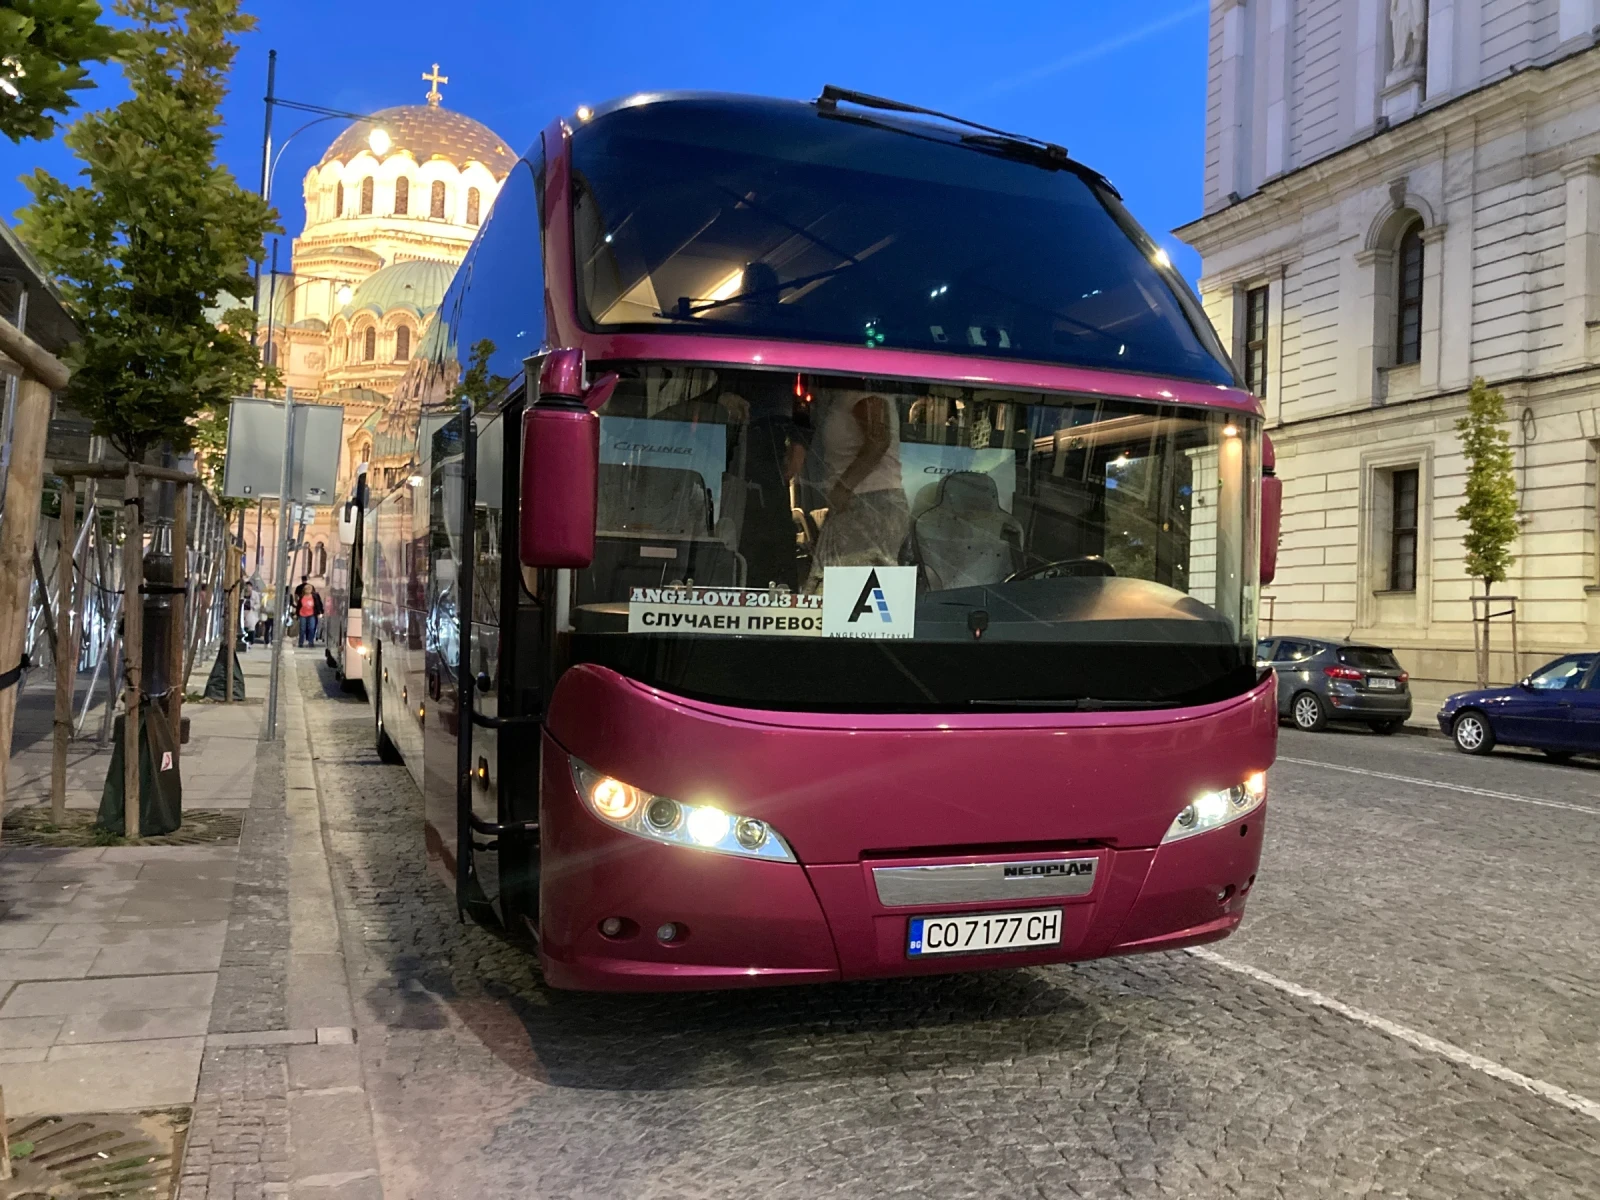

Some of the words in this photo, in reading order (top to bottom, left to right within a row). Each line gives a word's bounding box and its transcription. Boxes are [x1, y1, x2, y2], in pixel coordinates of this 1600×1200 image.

[614, 441, 693, 455] CITYLINER
[630, 588, 741, 606] ANGELOVI
[745, 592, 791, 608] 2013
[796, 594, 823, 609] LT
[642, 612, 740, 629] СЛУЧАЕН
[829, 631, 877, 639] ANGELOVI
[881, 631, 910, 639] Travel
[1004, 862, 1093, 877] NEOPLAN
[910, 940, 921, 949] BG
